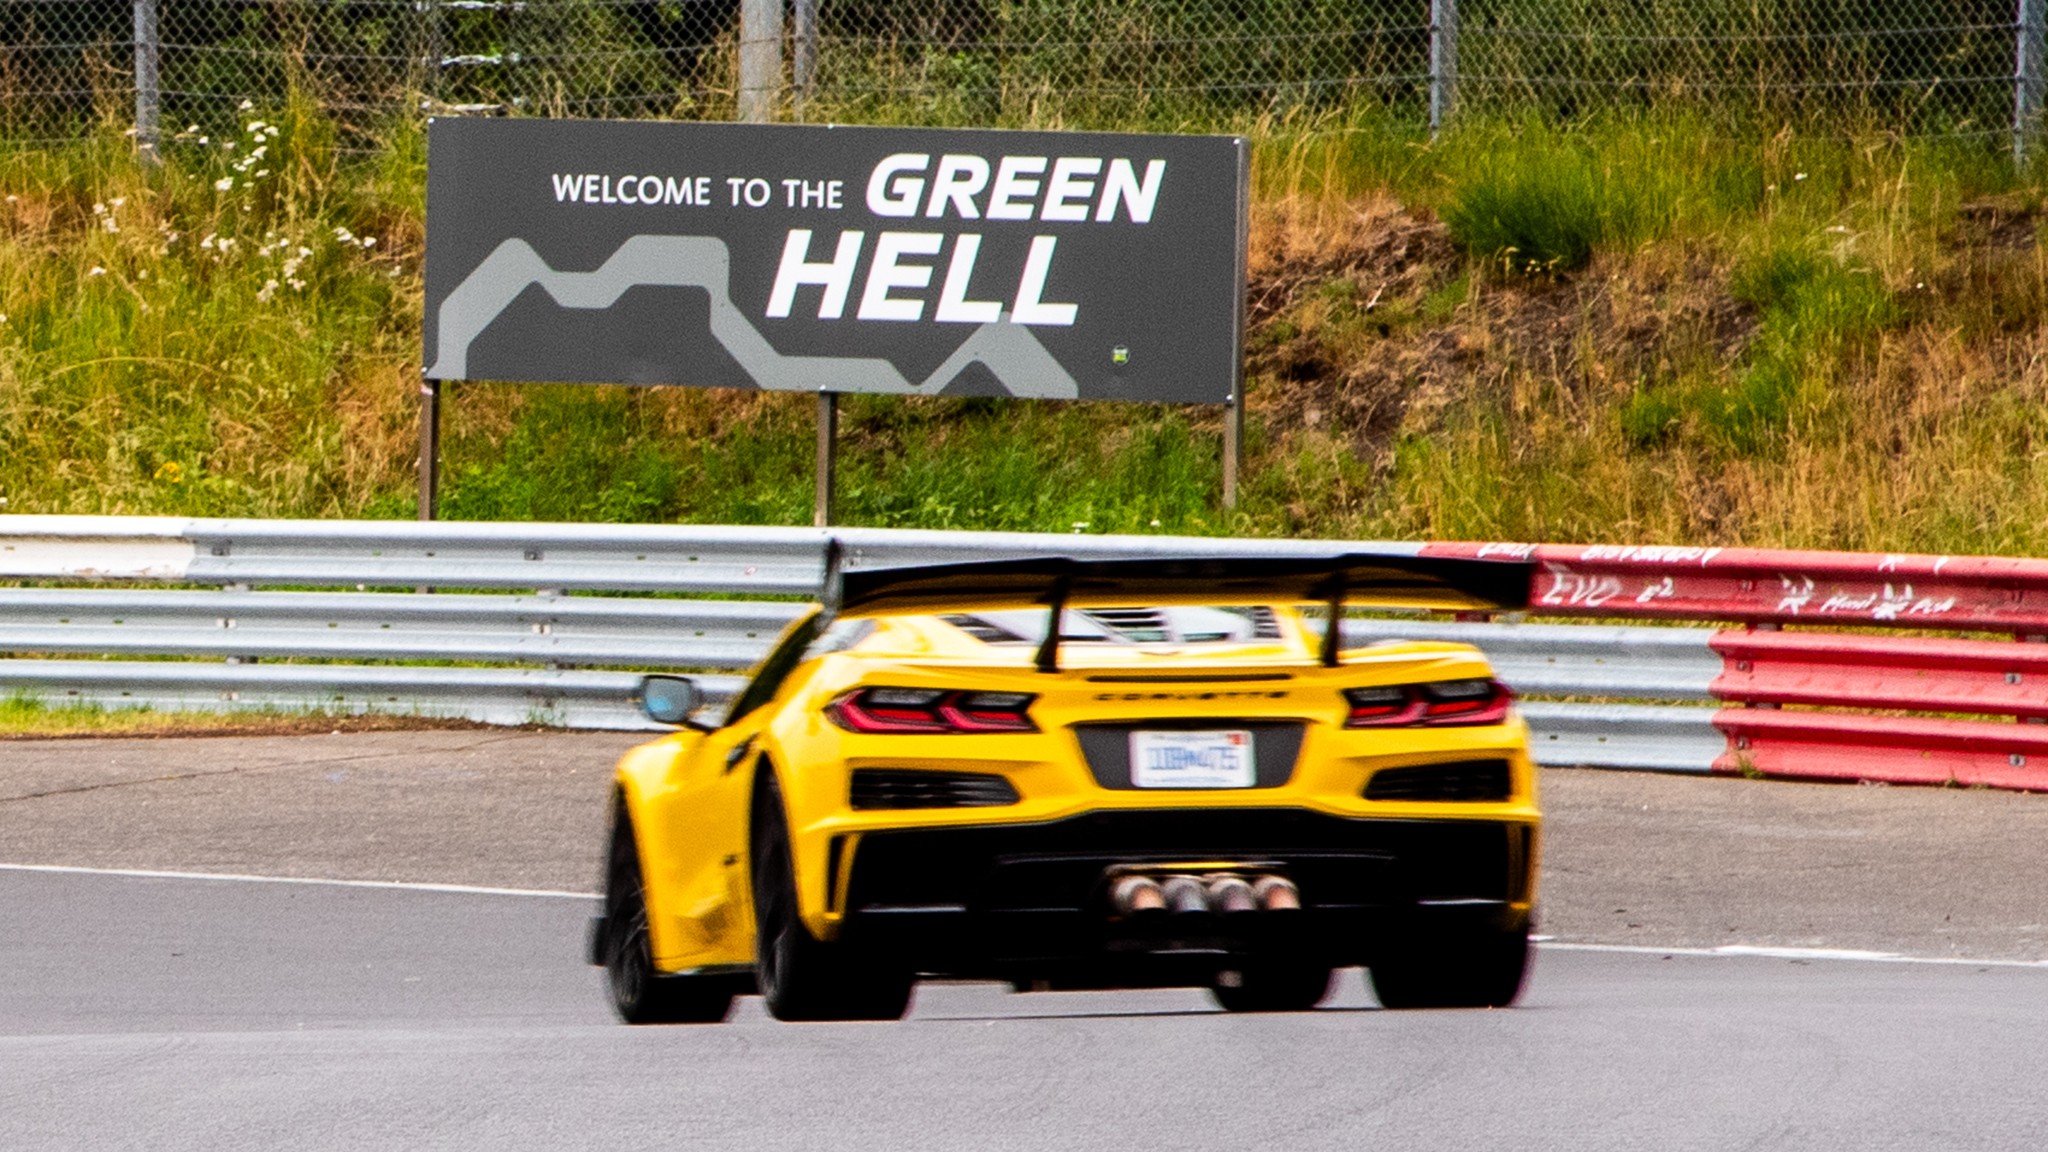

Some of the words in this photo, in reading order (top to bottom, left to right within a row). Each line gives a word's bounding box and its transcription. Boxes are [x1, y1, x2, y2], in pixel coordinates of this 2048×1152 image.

[551, 173, 712, 207] WELCOME
[726, 178, 772, 208] TO
[782, 179, 844, 210] THE
[865, 153, 1167, 224] GREEN
[765, 228, 1079, 326] HELL
